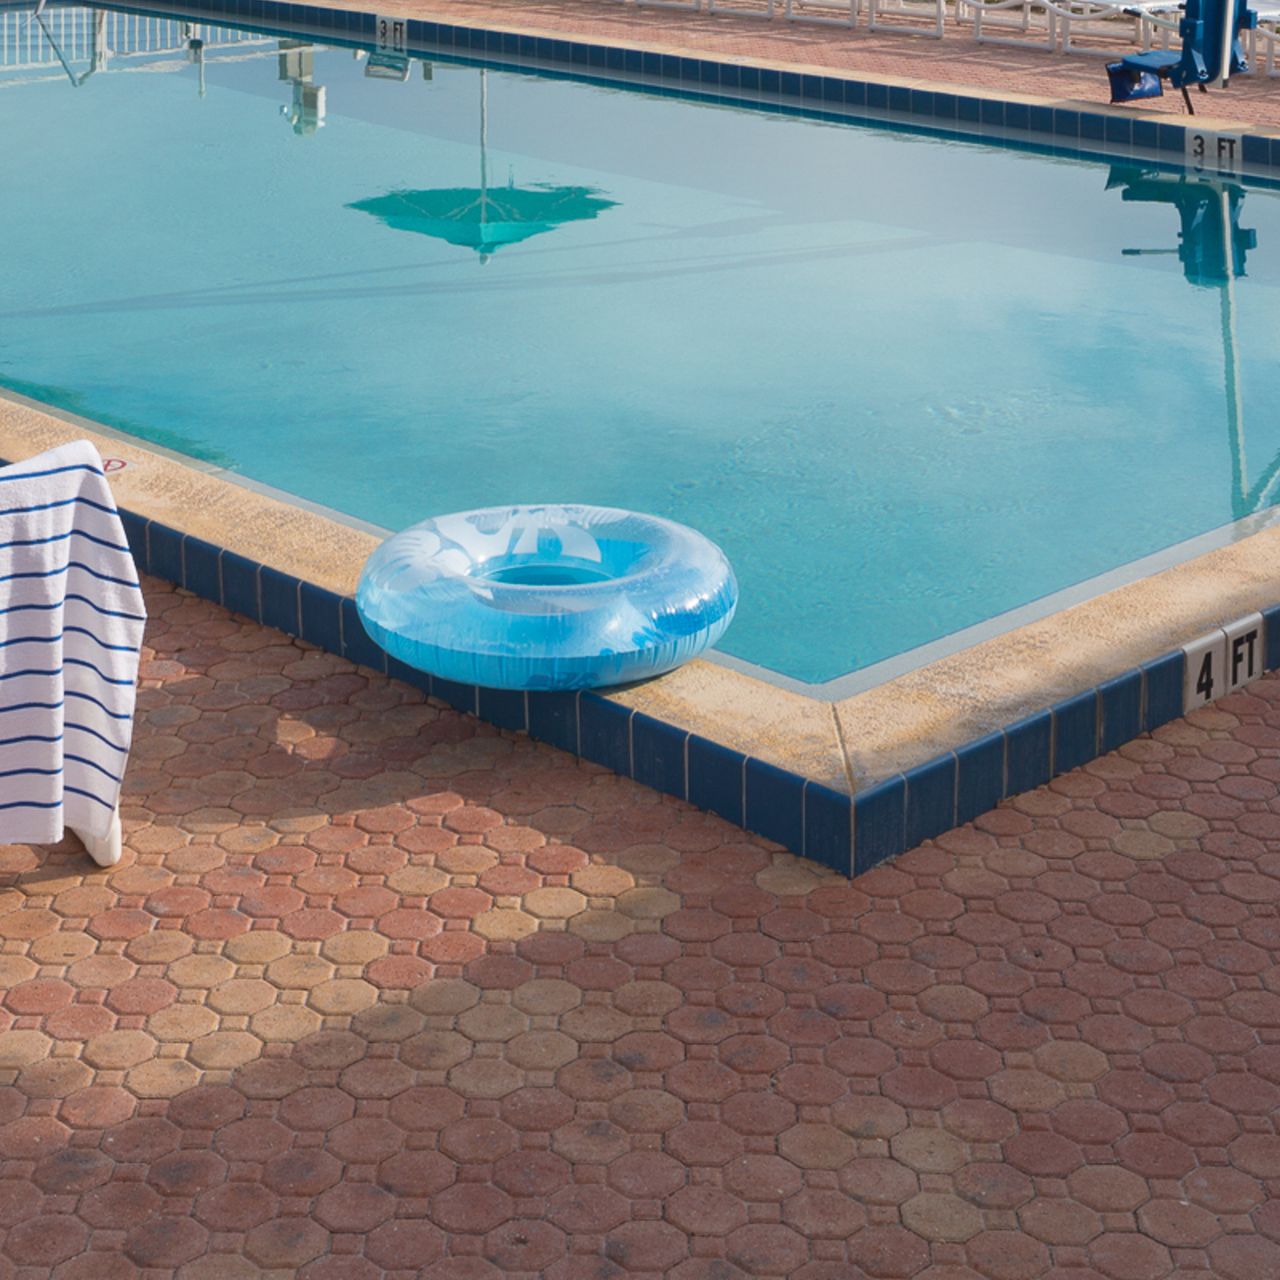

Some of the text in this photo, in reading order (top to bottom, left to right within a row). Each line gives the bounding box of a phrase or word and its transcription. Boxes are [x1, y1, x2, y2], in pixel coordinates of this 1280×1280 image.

[380, 20, 404, 38] 3 FT
[1192, 134, 1236, 159] 3 FT
[1196, 628, 1258, 701] 4 FT
